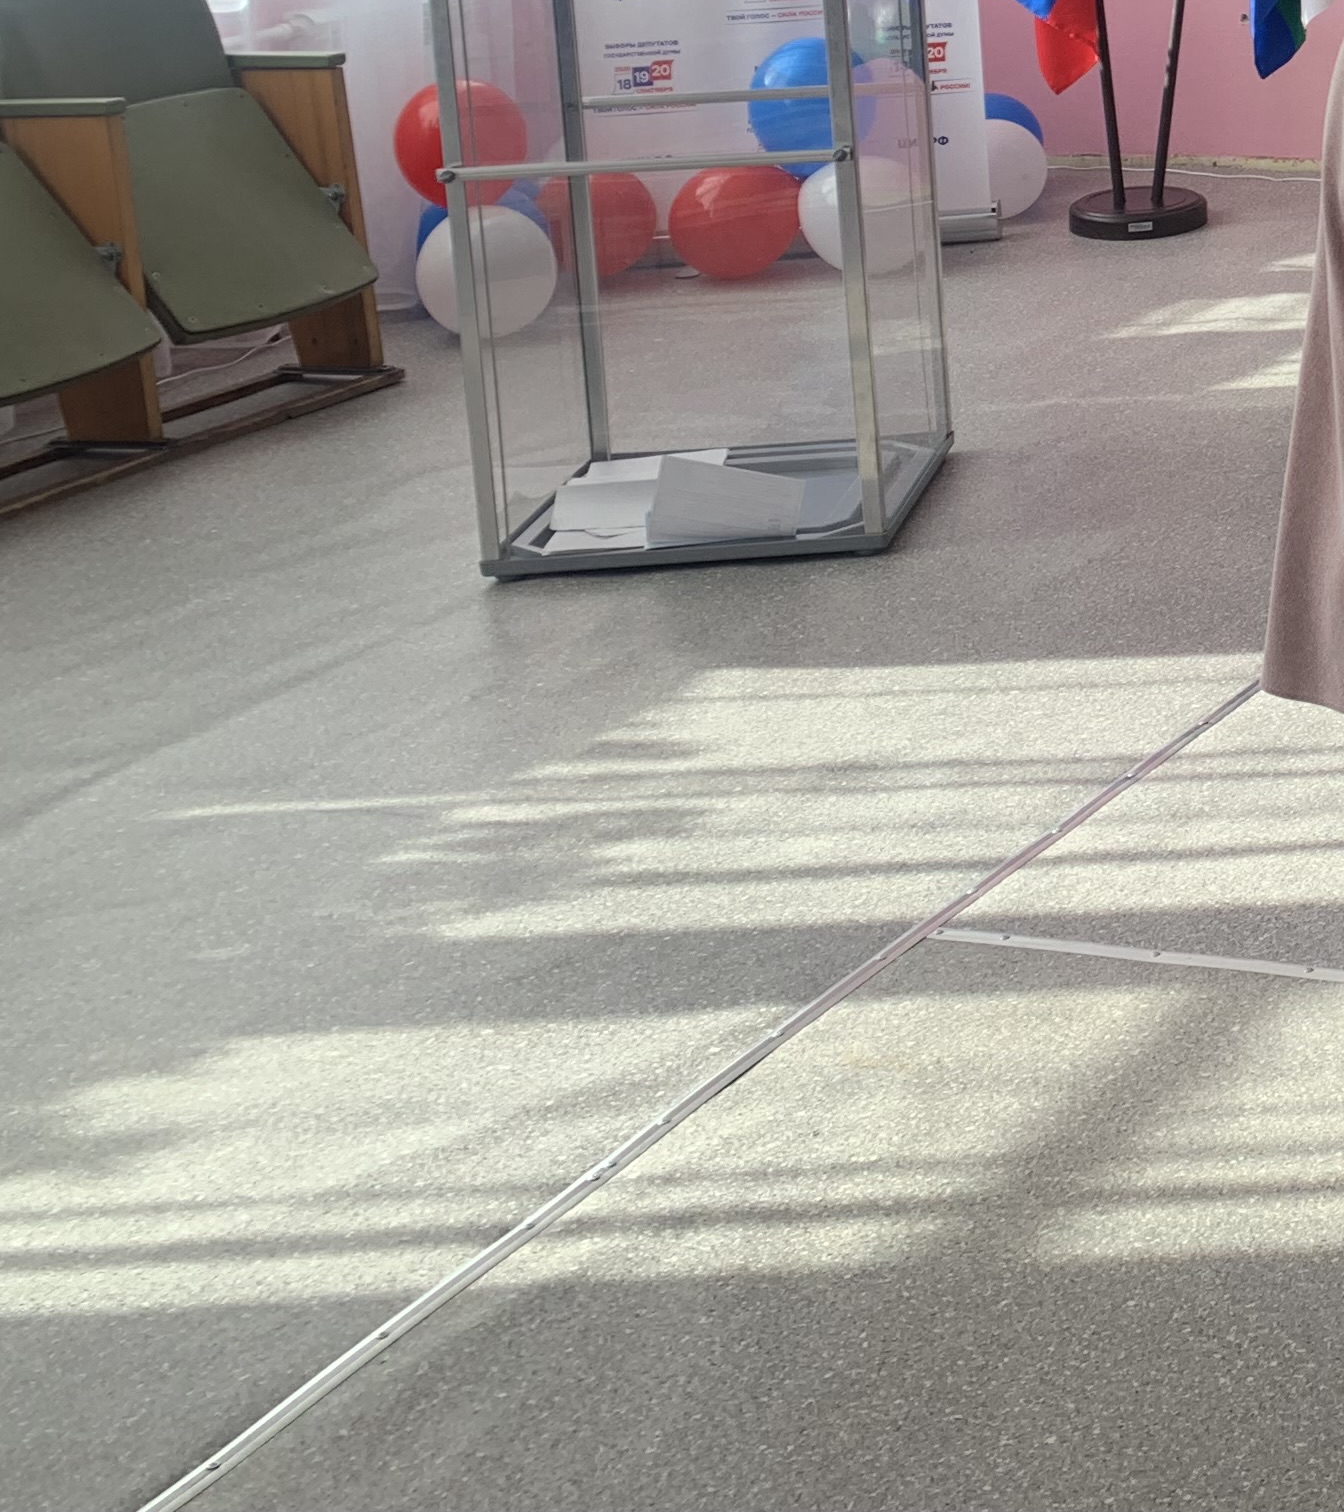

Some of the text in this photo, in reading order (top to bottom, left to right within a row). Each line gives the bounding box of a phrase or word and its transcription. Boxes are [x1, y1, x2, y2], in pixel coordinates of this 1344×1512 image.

[928, 47, 943, 58] 20
[617, 64, 670, 90] 18 19 20
